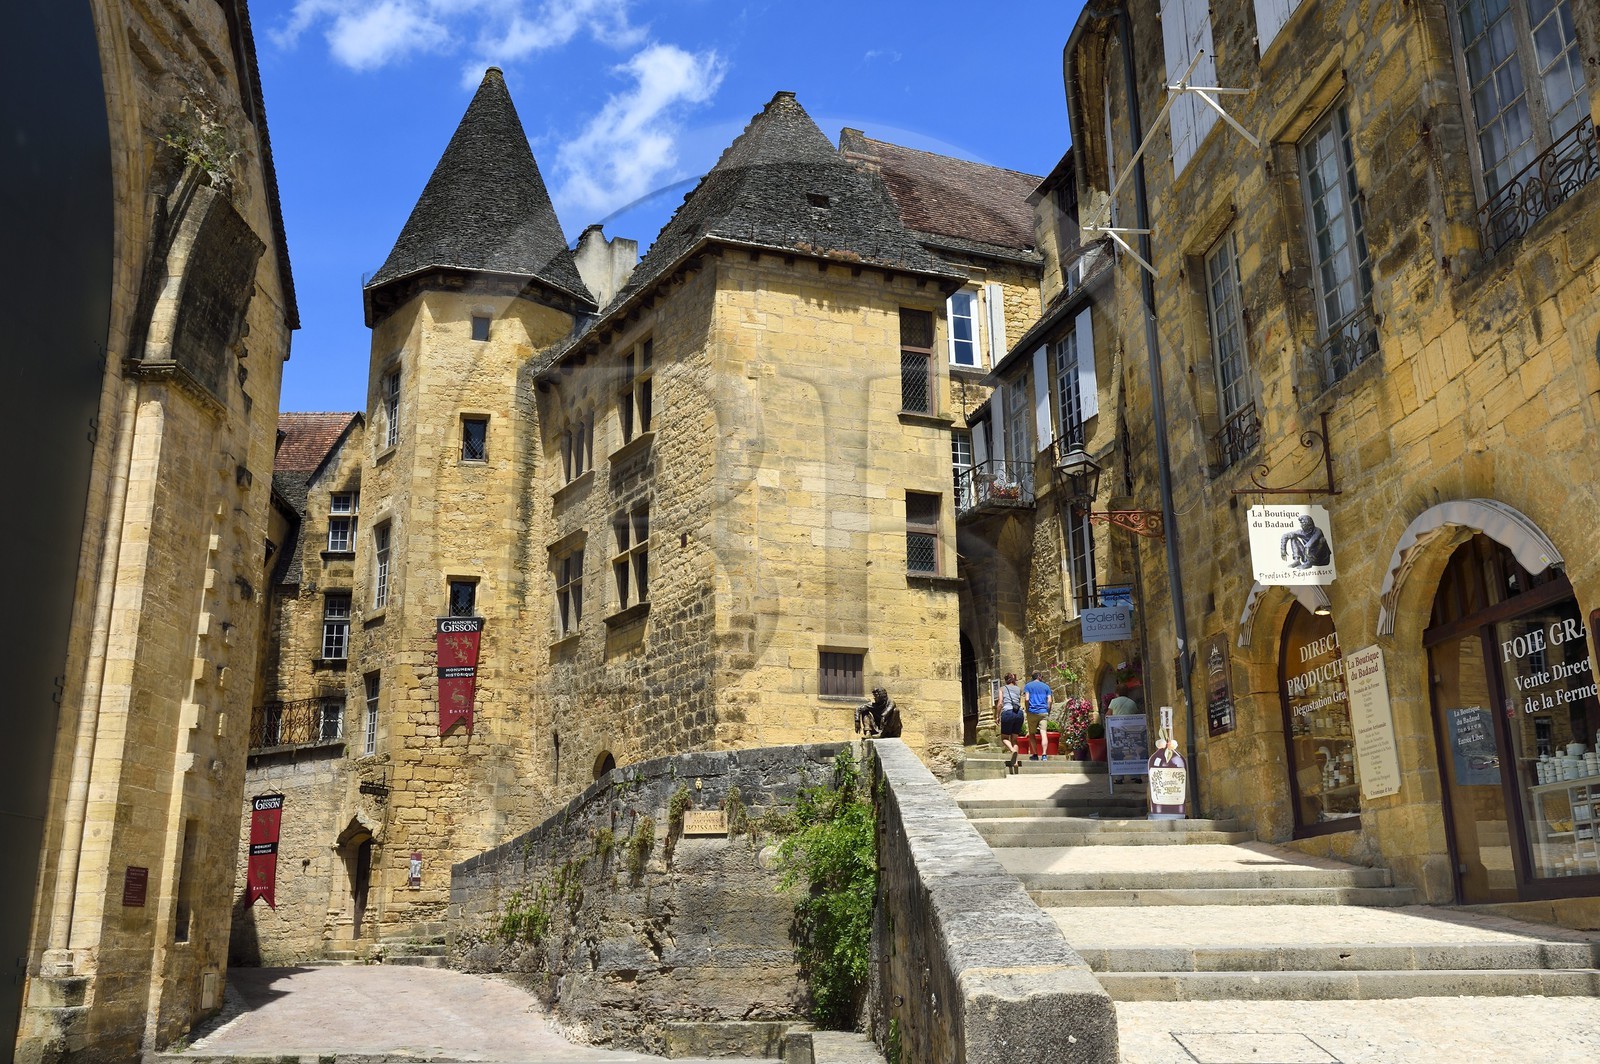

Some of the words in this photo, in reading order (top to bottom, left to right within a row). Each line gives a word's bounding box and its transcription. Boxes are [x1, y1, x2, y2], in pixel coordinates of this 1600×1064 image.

[1264, 510, 1300, 519] Boutique
[1259, 571, 1290, 581] Produits
[1086, 611, 1124, 623] Galerie
[440, 620, 478, 632] GISSON
[1098, 621, 1126, 630] Badaud
[1501, 629, 1546, 663] FOIE
[1348, 661, 1354, 670] La
[1355, 652, 1380, 666] Boutique
[1358, 662, 1378, 678] Badaud
[1514, 671, 1550, 692] Vente
[1524, 697, 1540, 714] de
[1540, 692, 1554, 710] la
[1555, 682, 1598, 706] Ferme
[1293, 696, 1332, 717] Dégustation
[1460, 706, 1480, 716] Boutique
[1462, 714, 1480, 724] Badaud
[256, 799, 280, 810] GISSON
